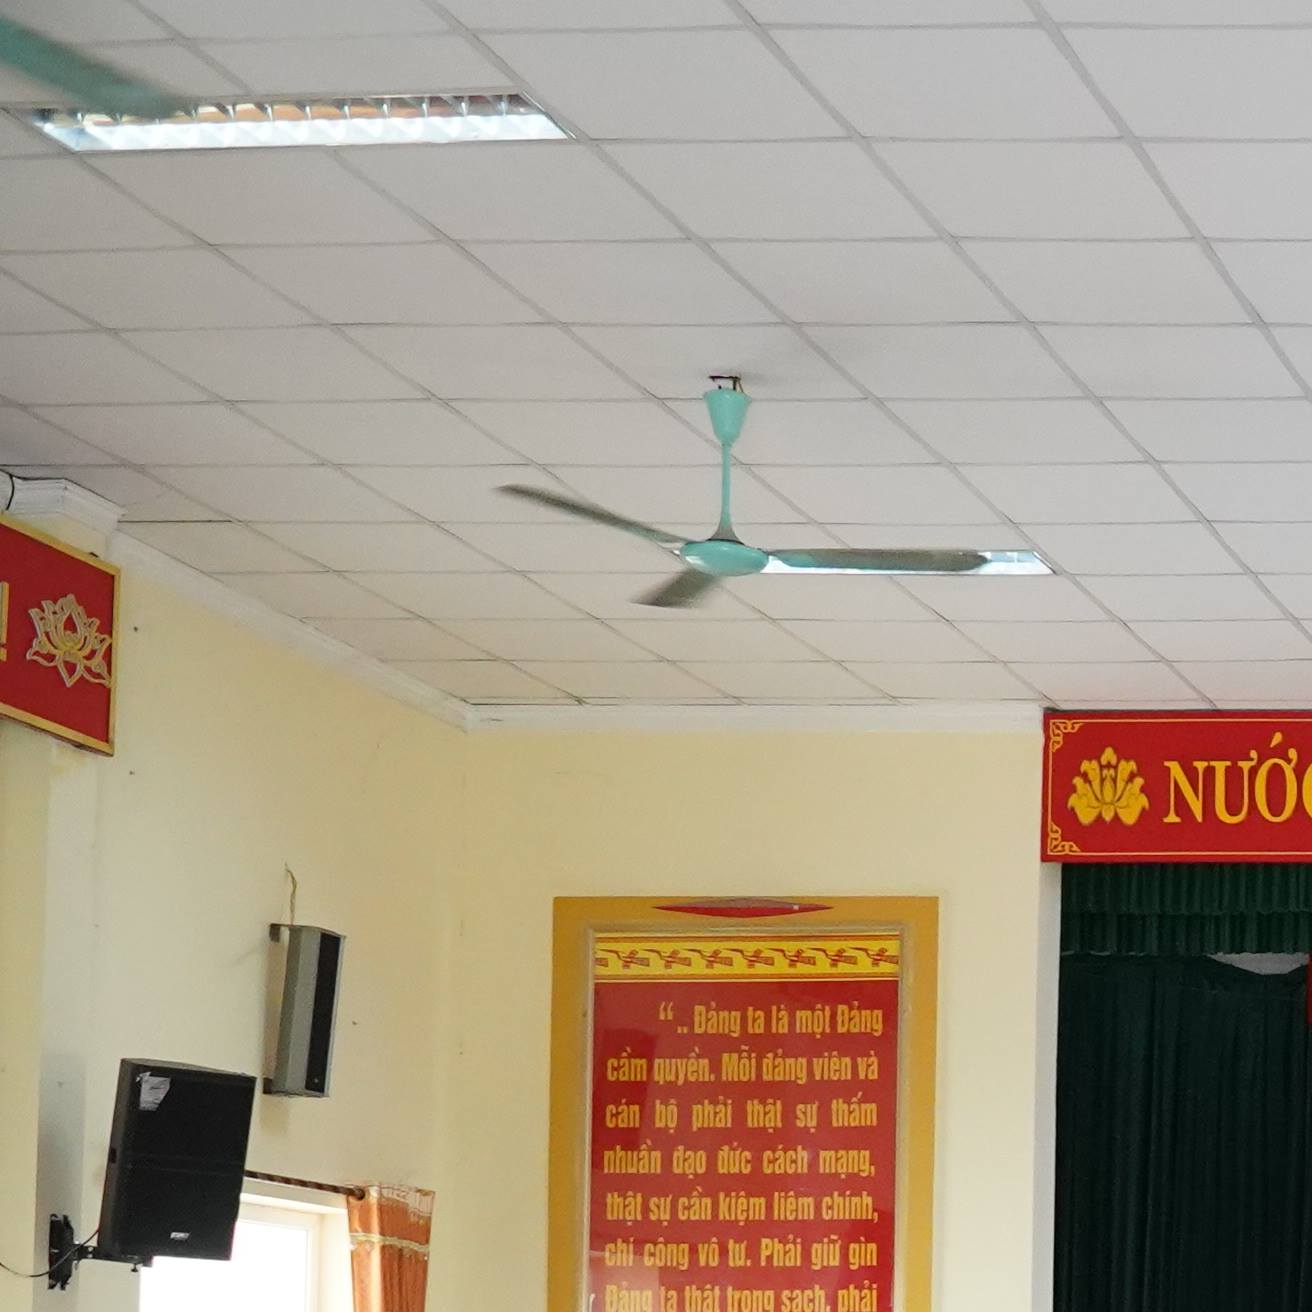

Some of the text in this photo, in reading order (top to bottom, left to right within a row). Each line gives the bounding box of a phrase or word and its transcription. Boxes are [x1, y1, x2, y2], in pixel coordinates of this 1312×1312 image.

[694, 1001, 740, 1037] Đảng
[747, 1006, 764, 1034] ta
[772, 1005, 788, 1034] là
[796, 1004, 830, 1038] một
[837, 1001, 883, 1036] Đảng
[722, 1046, 756, 1081] Mỗi
[813, 1052, 850, 1080] viên
[857, 1051, 877, 1080] và
[606, 1099, 640, 1128] cán
[655, 1100, 677, 1135] bộ
[692, 1096, 731, 1131] phải
[747, 1099, 781, 1132] thật
[796, 1102, 818, 1132] sự
[673, 1146, 706, 1178] đạo
[718, 1142, 751, 1174] đức
[762, 1145, 807, 1174] cách
[606, 1192, 642, 1225] thật
[650, 1194, 672, 1226] sự
[773, 1192, 813, 1220] liêm
[605, 1237, 633, 1266] chí
[644, 1237, 689, 1270] công
[699, 1237, 718, 1266] vô
[729, 1239, 750, 1266] tư.
[760, 1234, 801, 1266] Phải
[849, 1237, 877, 1270] gìn
